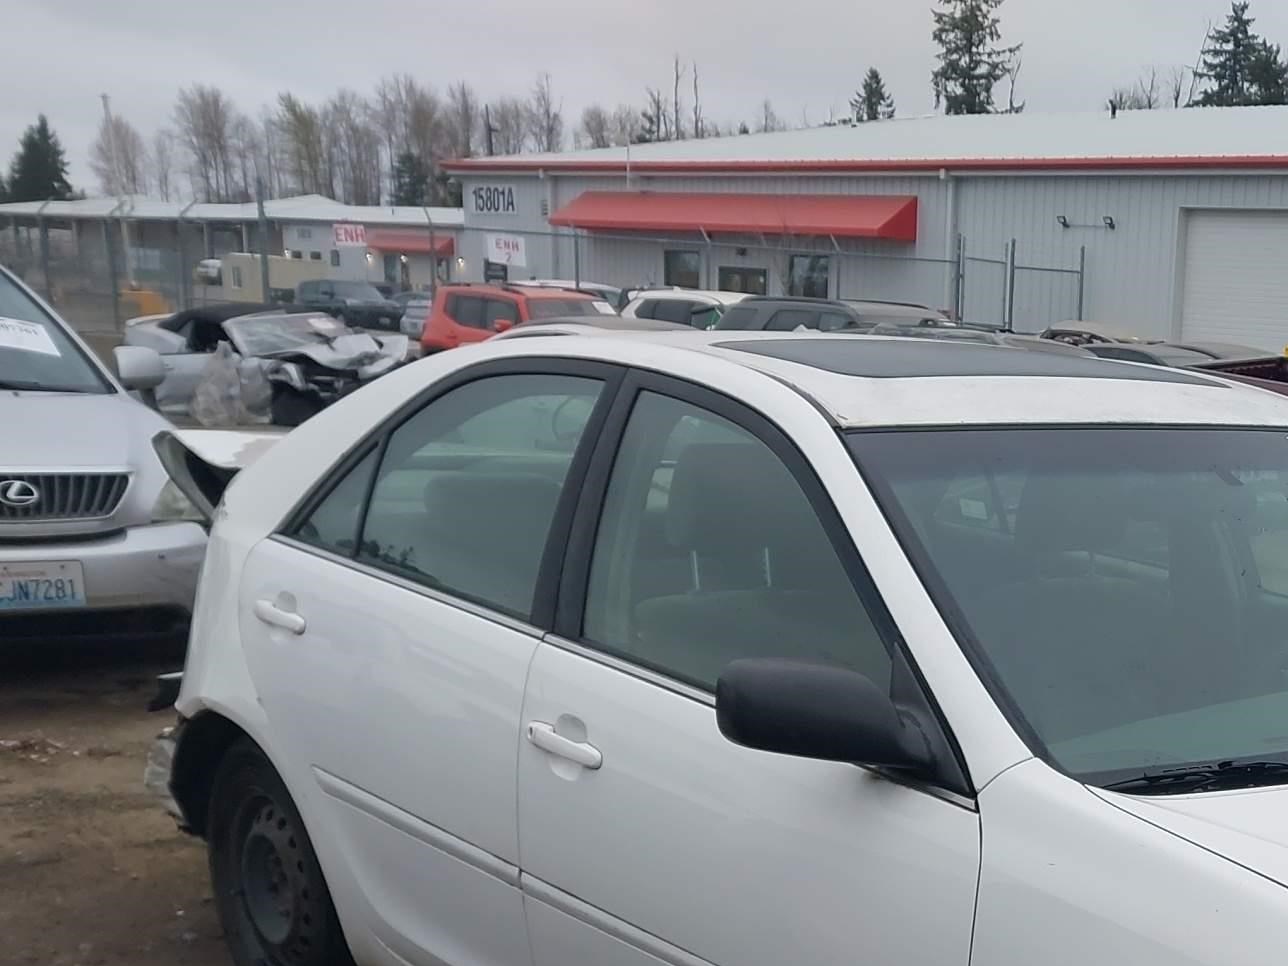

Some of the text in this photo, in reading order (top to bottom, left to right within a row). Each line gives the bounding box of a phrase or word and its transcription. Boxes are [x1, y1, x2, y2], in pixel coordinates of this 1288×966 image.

[472, 187, 515, 212] 15801A
[335, 226, 367, 242] ENH
[495, 239, 519, 252] ENH
